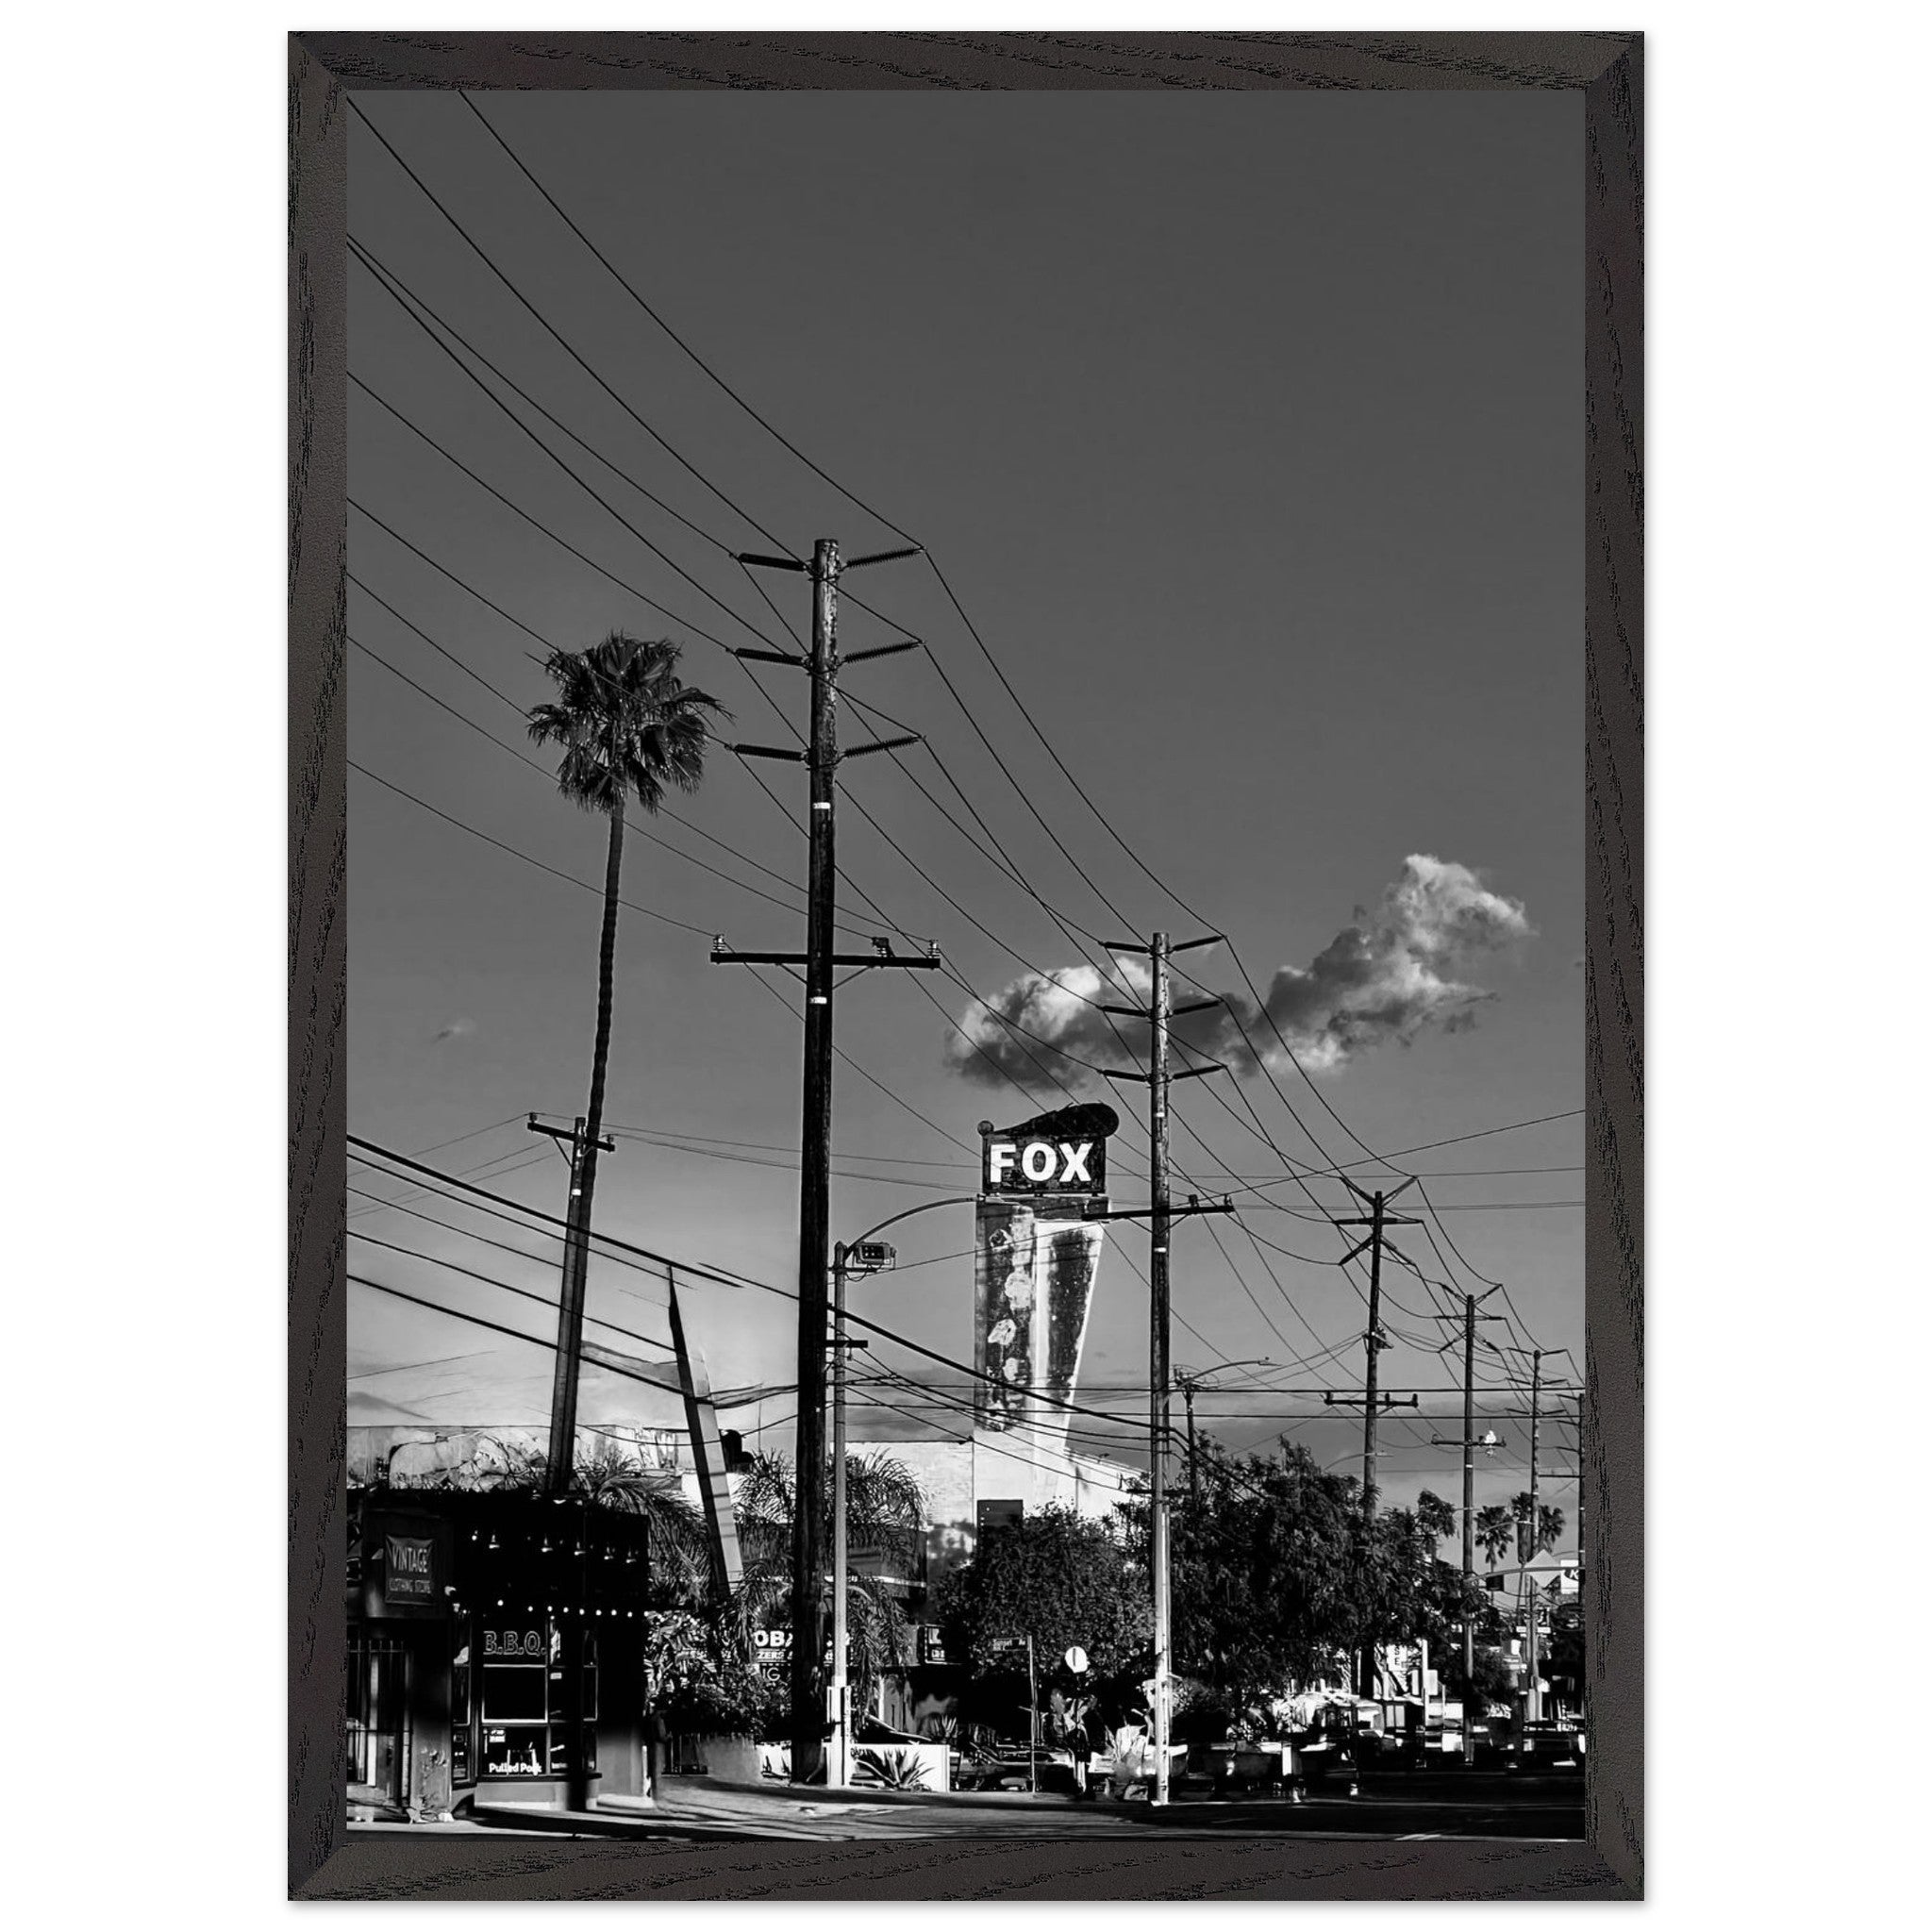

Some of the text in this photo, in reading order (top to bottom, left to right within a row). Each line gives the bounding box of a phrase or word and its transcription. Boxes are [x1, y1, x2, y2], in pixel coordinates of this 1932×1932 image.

[990, 1142, 1093, 1183] FOX
[392, 1545, 427, 1574] VINTAGE
[483, 1630, 547, 1657] B.B.Q.
[520, 1762, 542, 1774] Pok
